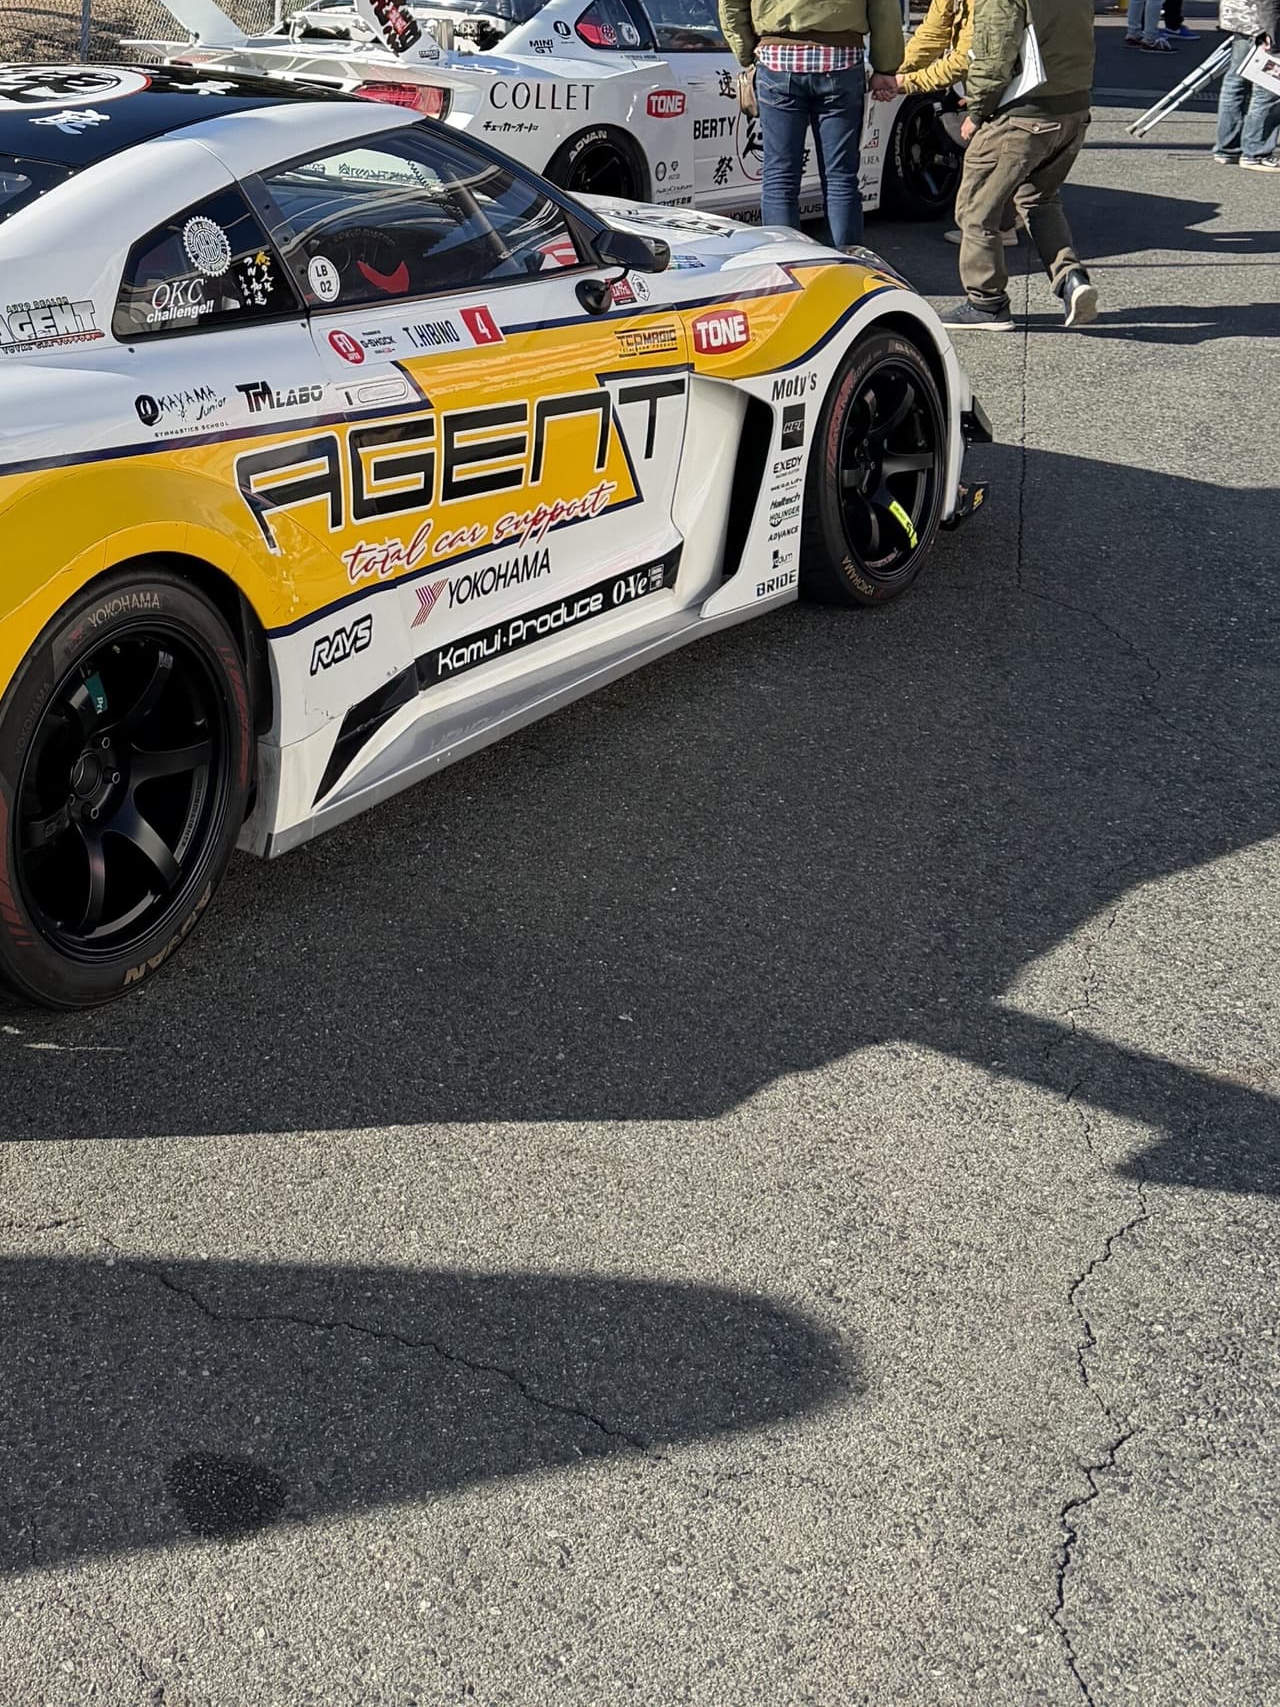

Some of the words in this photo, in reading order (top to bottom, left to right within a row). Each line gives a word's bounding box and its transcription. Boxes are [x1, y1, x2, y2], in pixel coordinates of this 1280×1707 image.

[529, 39, 553, 48] MINI
[489, 81, 595, 110] COLLET
[650, 97, 683, 115] TONE
[693, 116, 736, 141] BERTY
[570, 130, 608, 160] ADVAN
[315, 264, 329, 277] LB
[152, 279, 206, 310] OKC
[320, 279, 334, 293] 02
[402, 320, 461, 349] T.HIBINO
[474, 311, 493, 341] 4
[696, 315, 747, 350] TONE
[772, 372, 818, 402] Moty's
[235, 378, 687, 554] AGENT
[772, 455, 803, 474] EXEDY
[770, 492, 800, 510] Haltech
[342, 522, 434, 578] total
[436, 524, 489, 555] car
[490, 484, 614, 548] support
[767, 526, 799, 542] ADVANCE
[448, 548, 551, 609] YOKOHAMA
[756, 569, 797, 597] BRIDE
[88, 591, 160, 628] YOKOHAMA
[311, 614, 373, 675] RAYS
